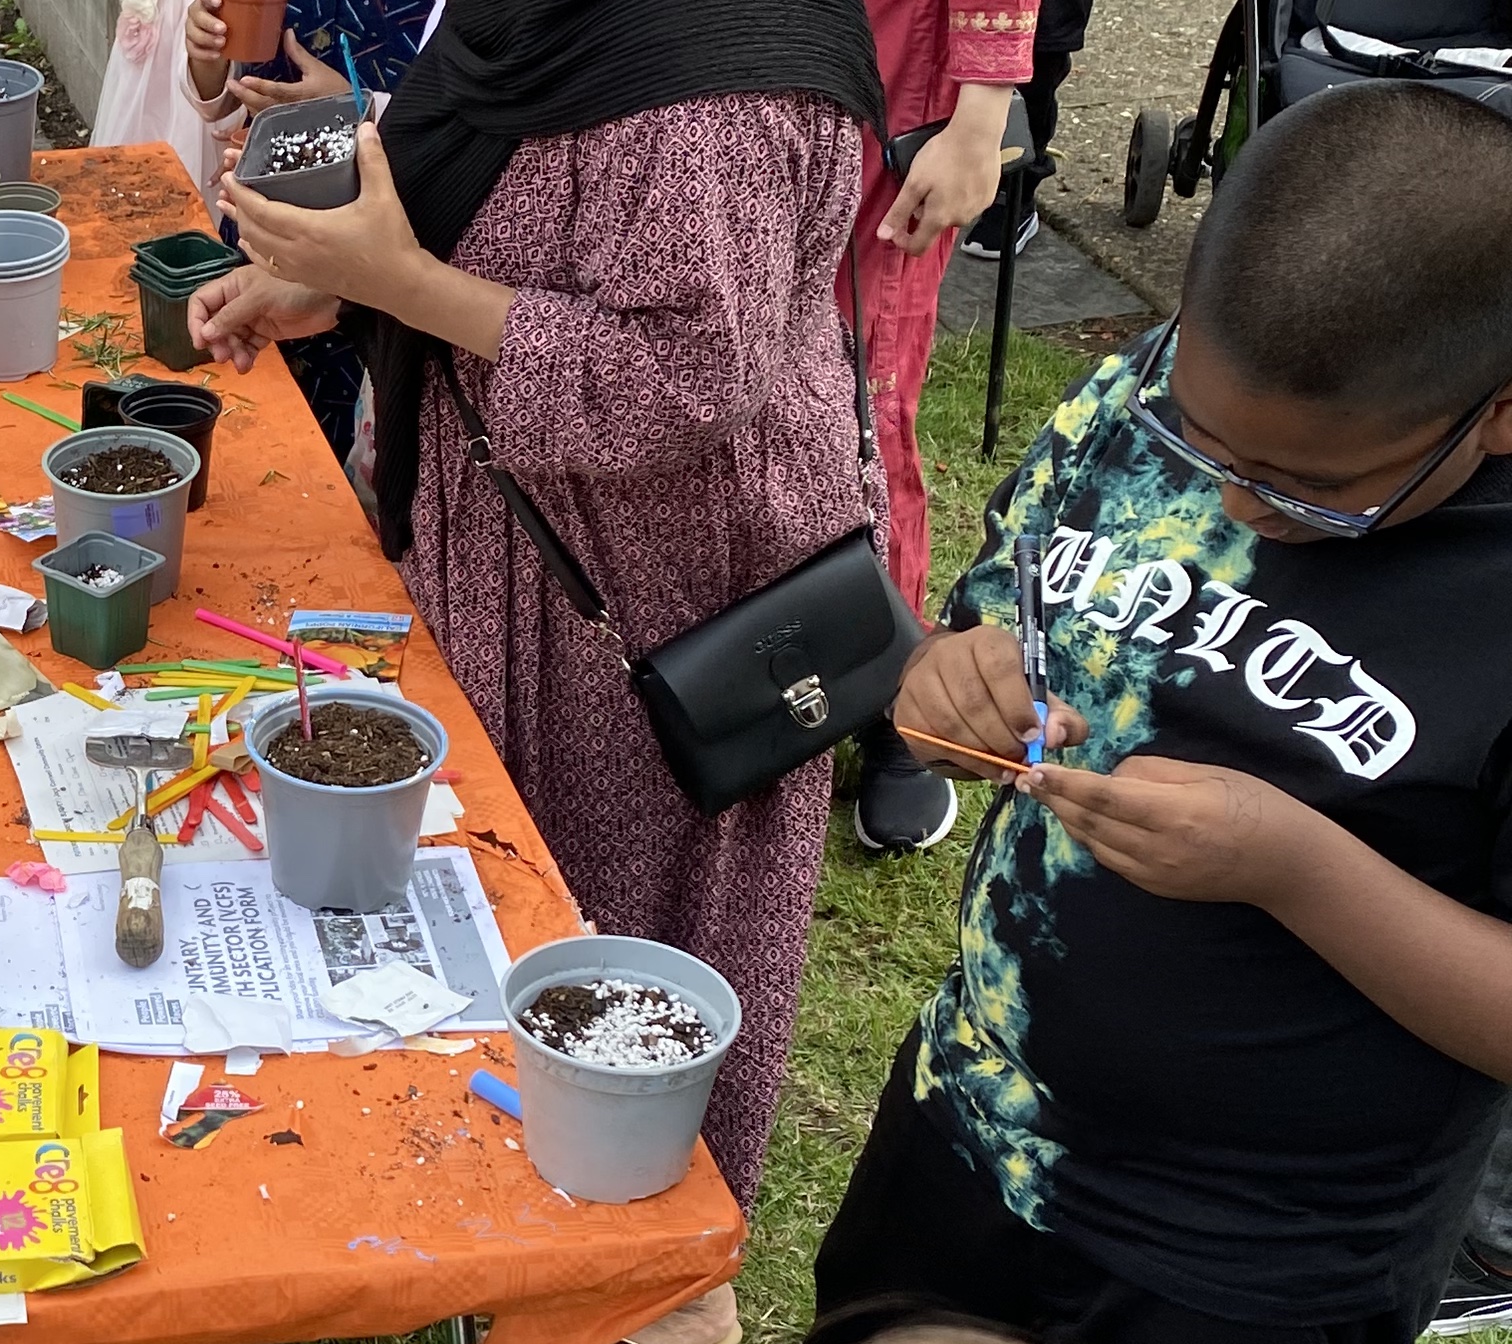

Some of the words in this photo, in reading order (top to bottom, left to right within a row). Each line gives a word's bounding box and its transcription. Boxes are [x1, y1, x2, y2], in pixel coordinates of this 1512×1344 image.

[194, 898, 216, 927] AND
[211, 881, 238, 923] (VCFS)
[236, 887, 262, 924] FORM
[223, 925, 252, 977] SECTOR
[0, 1033, 48, 1079] Cre8
[17, 1082, 31, 1112] chalks
[29, 1082, 45, 1131] pavement
[214, 1090, 241, 1098] 25%
[29, 1143, 79, 1194] Cre8
[50, 1198, 67, 1234] chalks
[61, 1198, 84, 1255] pavement
